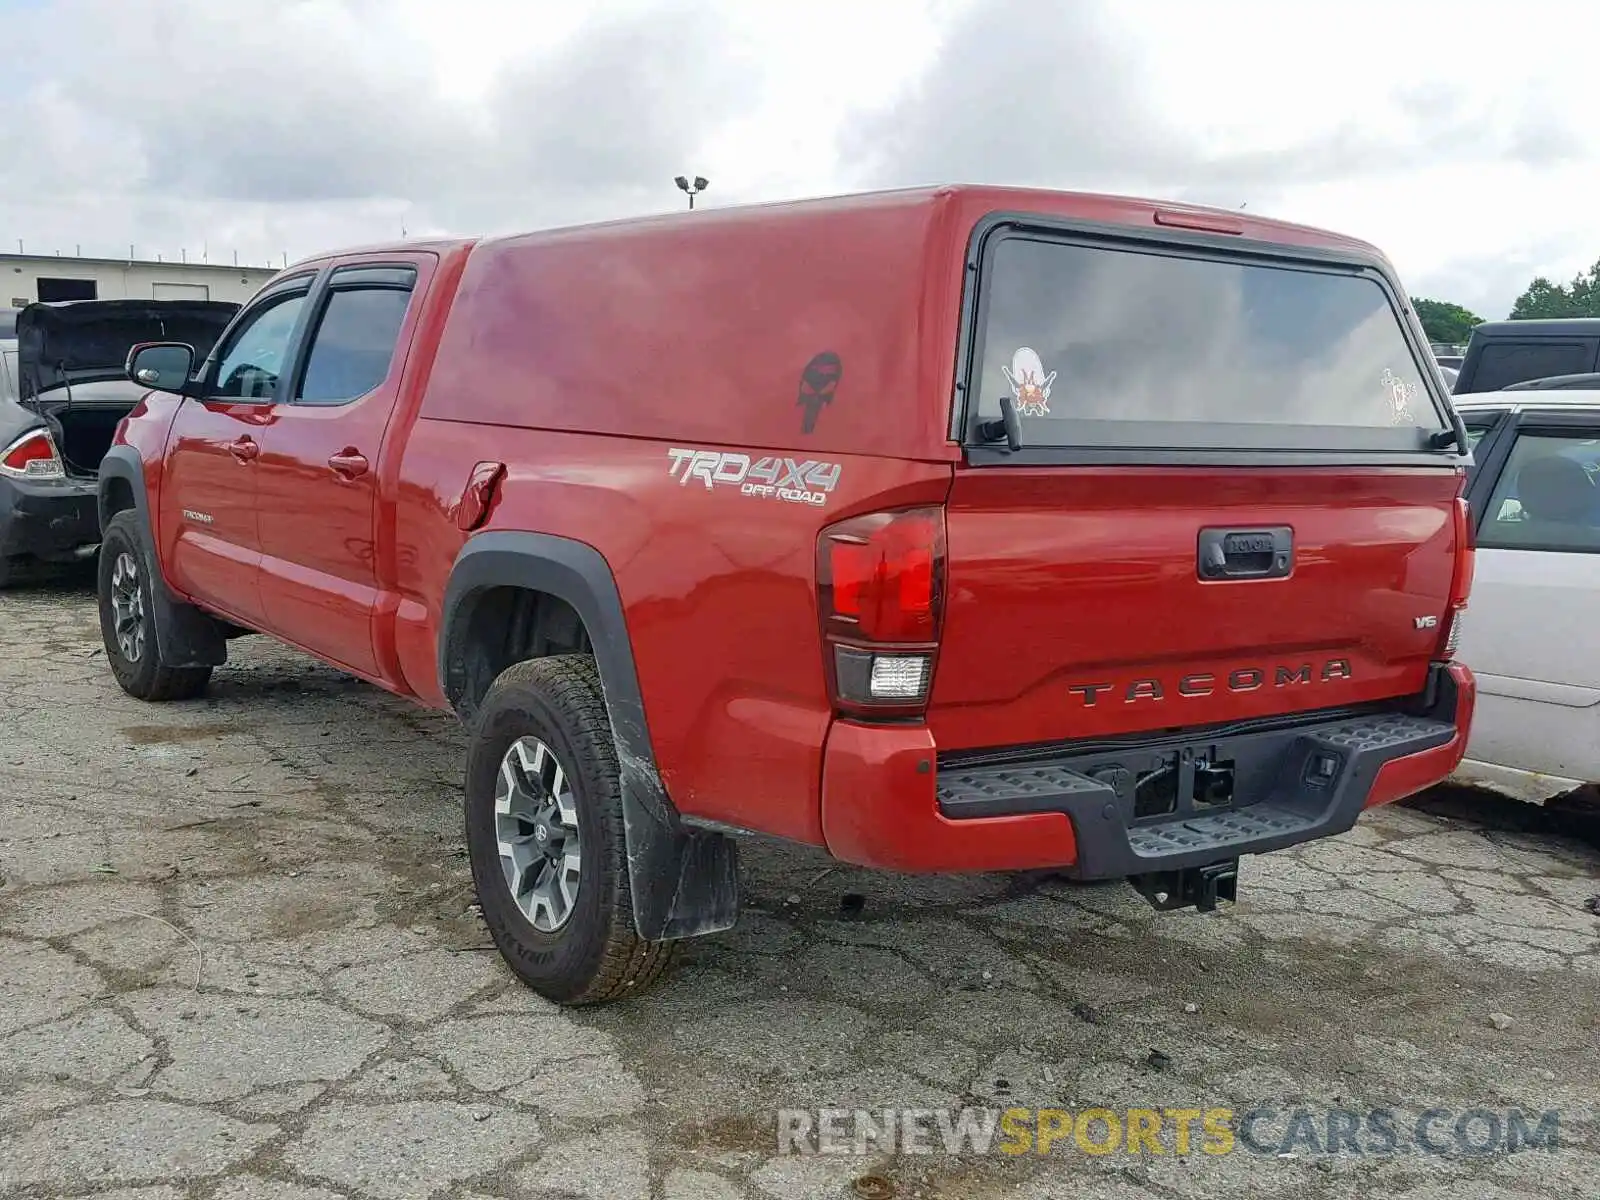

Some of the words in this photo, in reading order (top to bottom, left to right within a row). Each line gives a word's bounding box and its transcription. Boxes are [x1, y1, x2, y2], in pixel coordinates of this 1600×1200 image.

[741, 483, 776, 499] OFF
[776, 487, 827, 506] ROAD
[1414, 615, 1437, 629] V6
[1069, 659, 1353, 707] TACOMA
